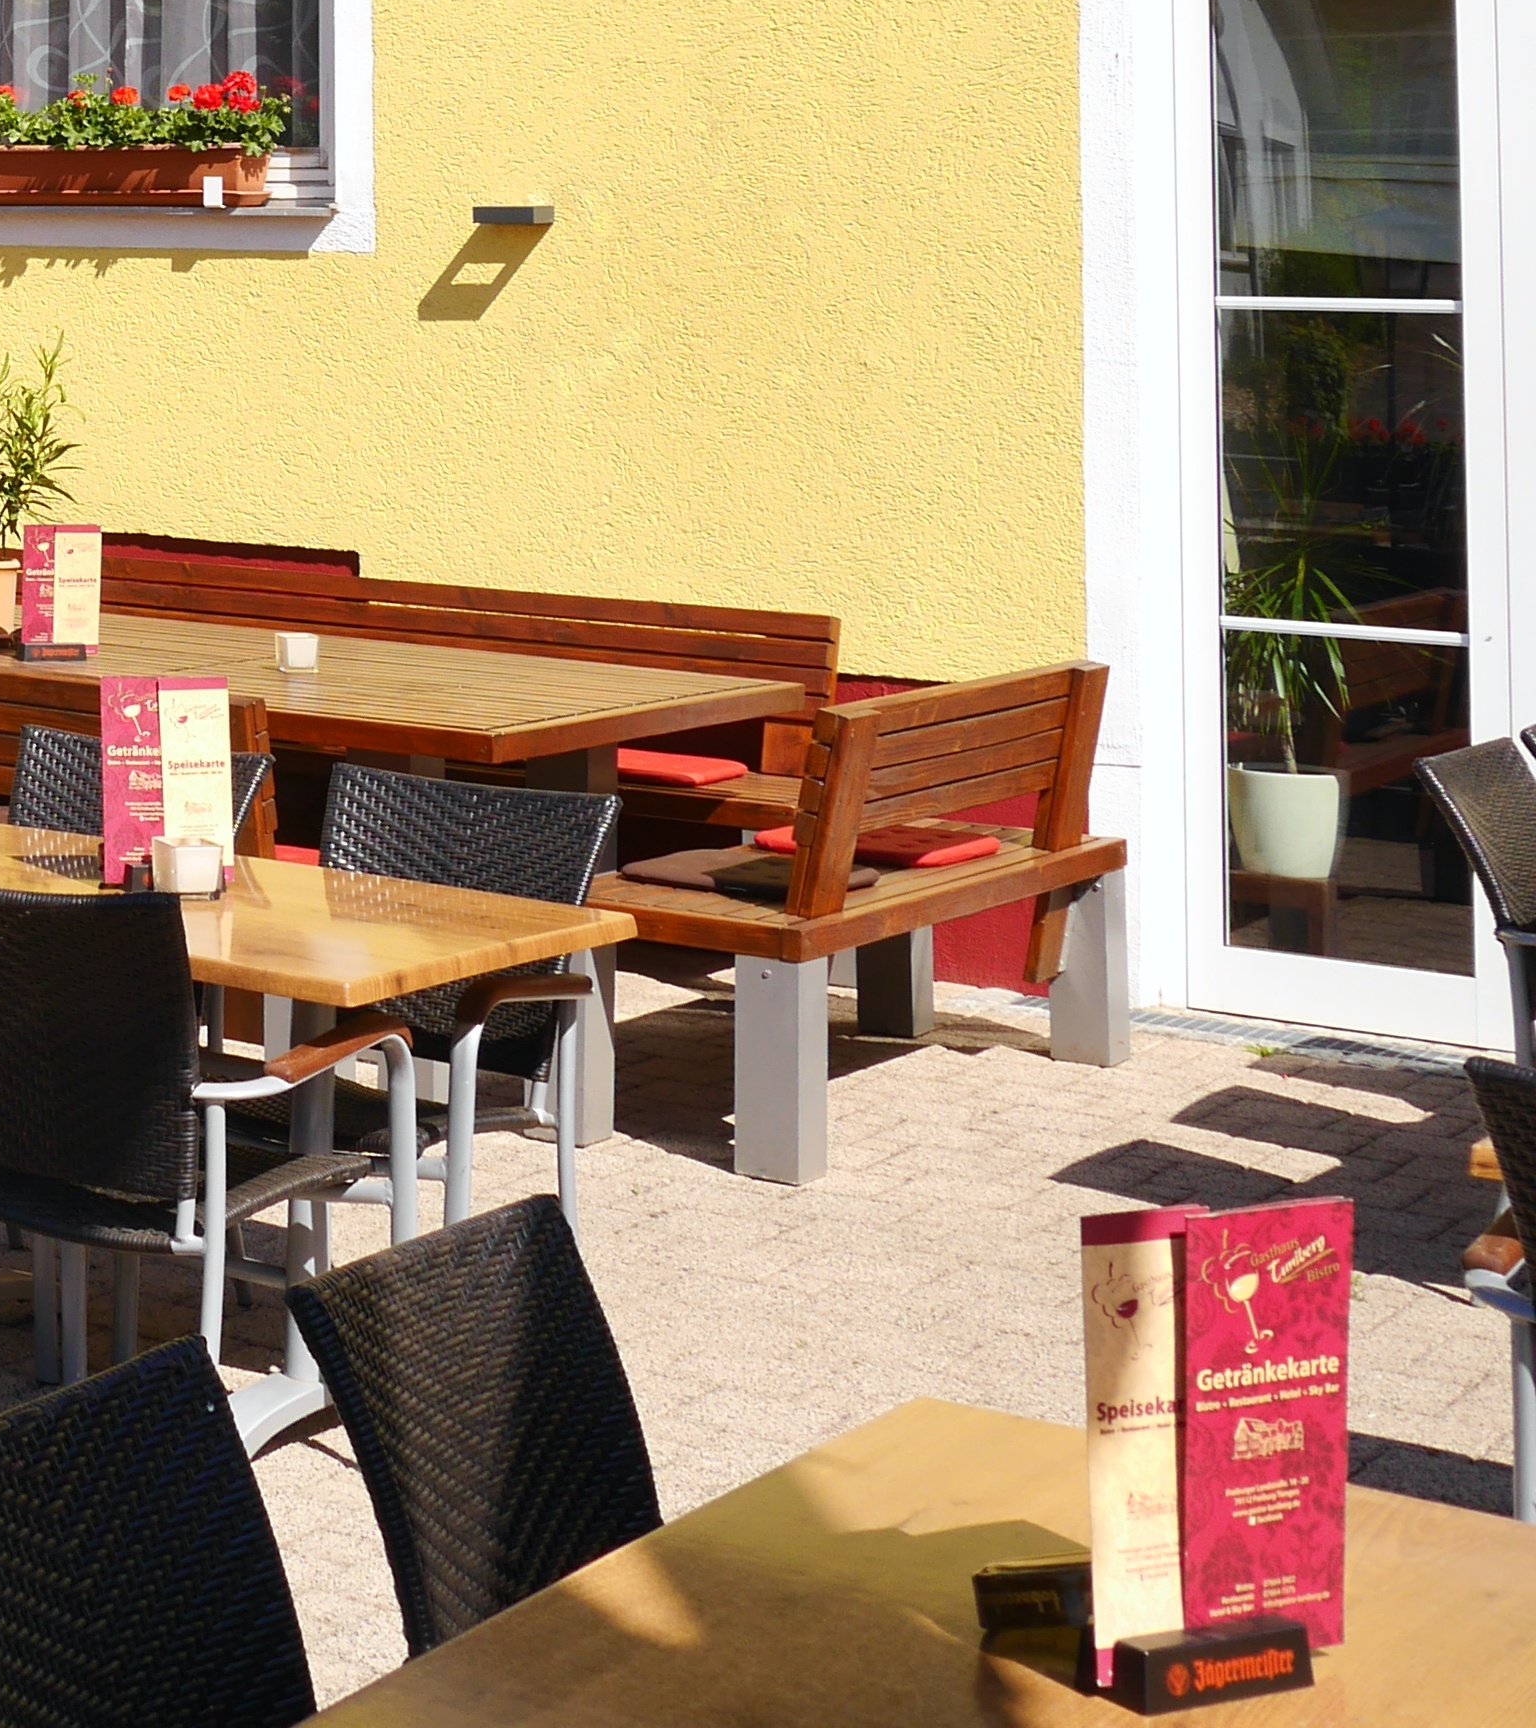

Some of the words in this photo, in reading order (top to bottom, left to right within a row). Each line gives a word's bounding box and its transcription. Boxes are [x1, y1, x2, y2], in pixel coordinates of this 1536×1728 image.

[107, 744, 161, 757] Getränke
[168, 759, 226, 770] Speisekarte
[1250, 1238, 1300, 1267] Gasthaus
[1266, 1234, 1326, 1284] Tuniberg
[1306, 1262, 1341, 1283] Bistro
[1196, 1354, 1341, 1392] Getränkekarte
[1195, 1401, 1221, 1412] Bistro
[1228, 1393, 1272, 1408] Restaurant
[1279, 1387, 1302, 1400] Hotel
[1325, 1382, 1340, 1394] Bar
